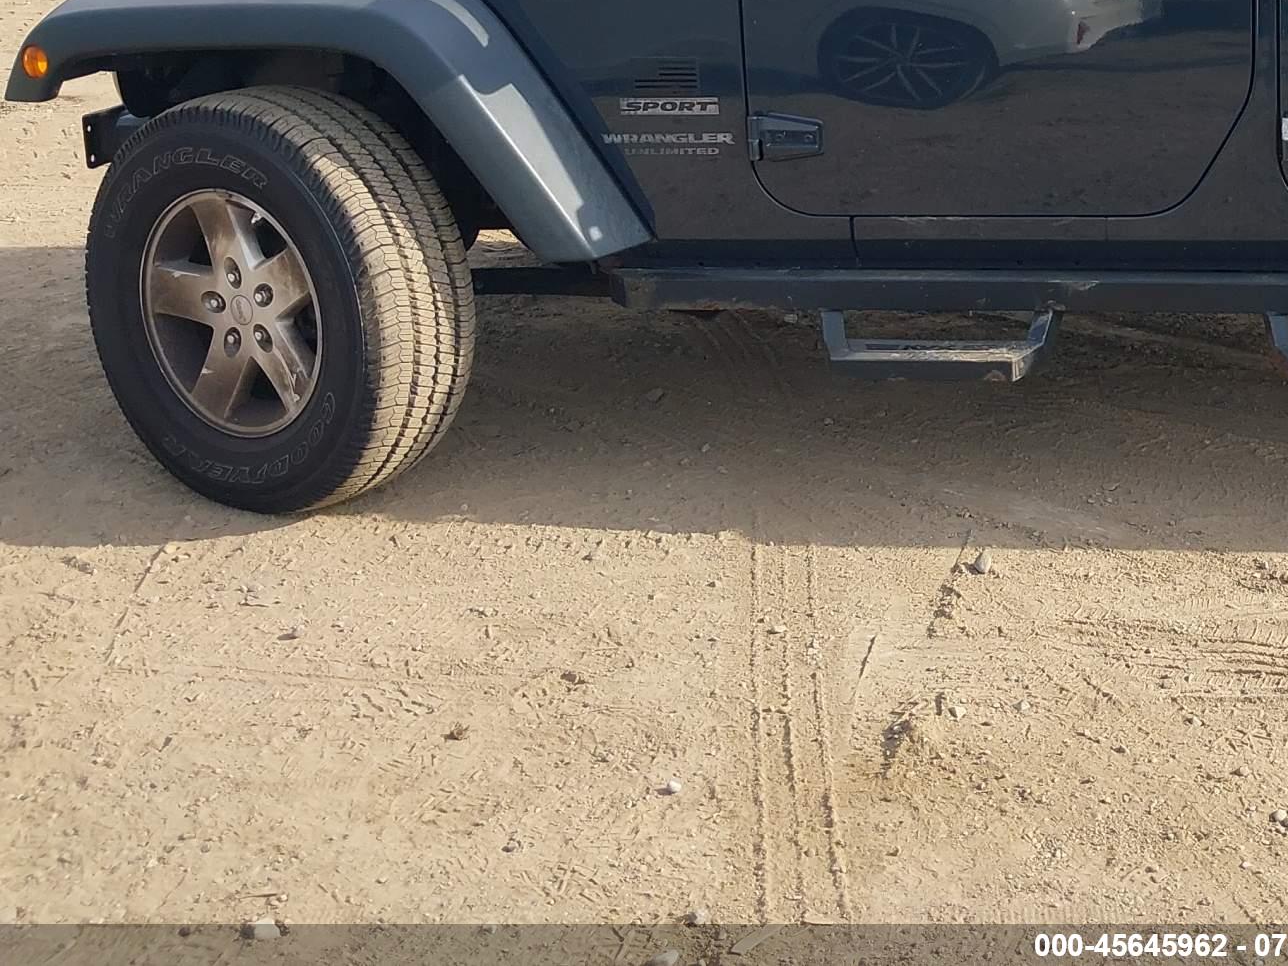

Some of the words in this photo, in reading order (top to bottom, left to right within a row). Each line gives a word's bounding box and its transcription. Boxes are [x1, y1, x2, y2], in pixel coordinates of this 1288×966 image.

[620, 101, 719, 112] SPORT
[601, 133, 735, 145] WRANGLER
[624, 147, 719, 155] UNLIMITED
[104, 146, 268, 238] WRANGLER
